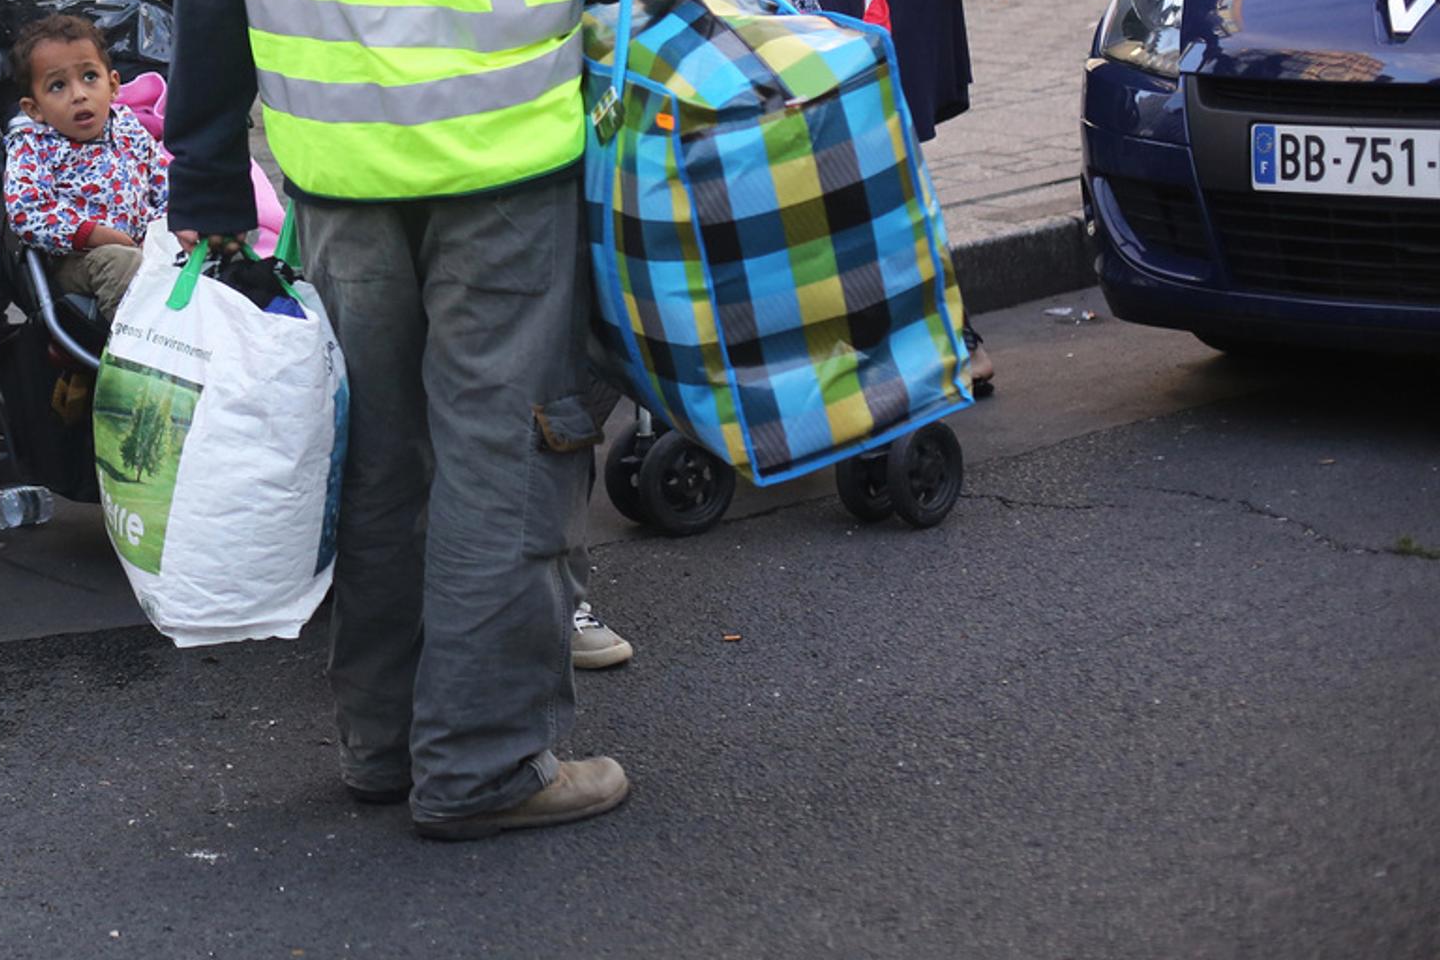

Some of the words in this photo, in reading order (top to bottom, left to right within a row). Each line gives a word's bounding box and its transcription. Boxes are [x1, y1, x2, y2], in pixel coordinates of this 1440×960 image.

[1260, 161, 1269, 175] F
[1280, 133, 1440, 187] BB-751-
[112, 322, 143, 339] geons
